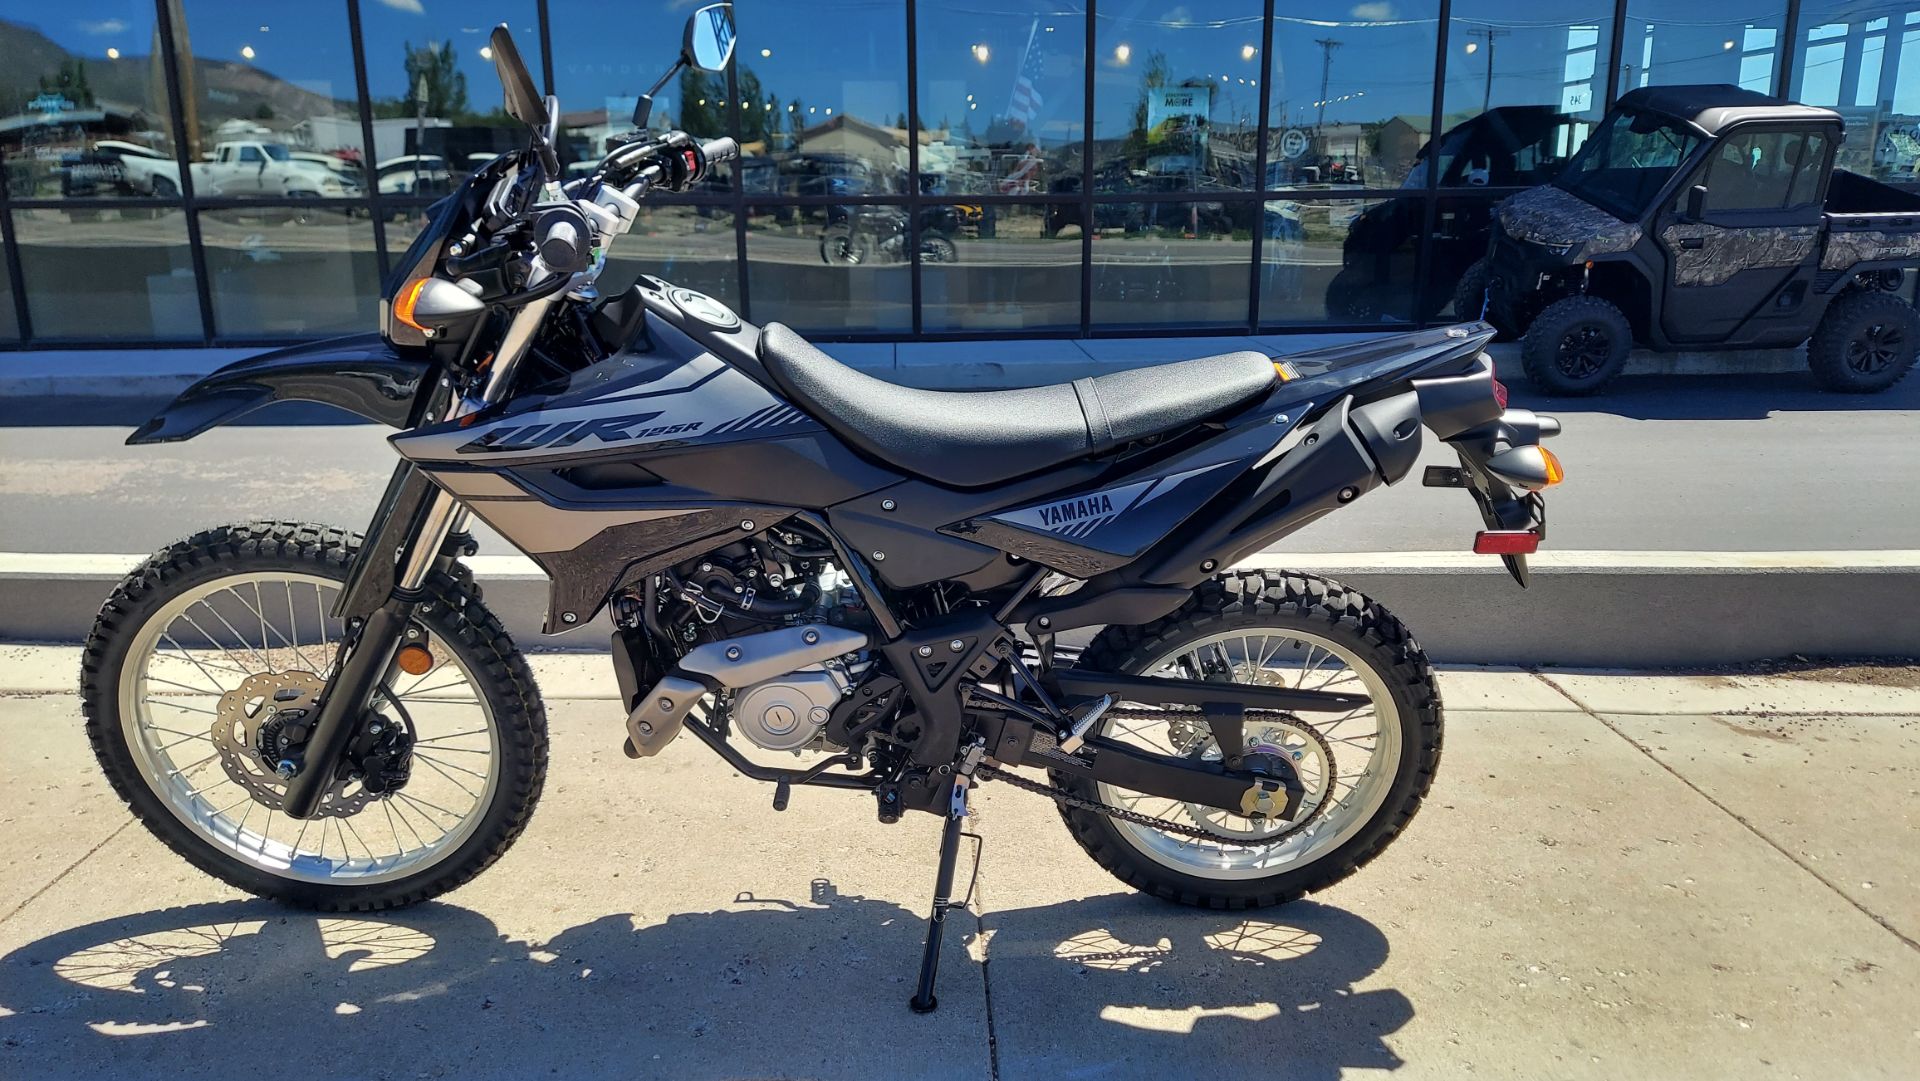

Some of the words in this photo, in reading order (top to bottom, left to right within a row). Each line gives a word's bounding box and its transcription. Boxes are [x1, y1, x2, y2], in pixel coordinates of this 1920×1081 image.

[1164, 98, 1193, 107] MORE
[455, 410, 666, 454] WR
[635, 421, 703, 438] 125R
[1038, 494, 1113, 526] YAMAHA
